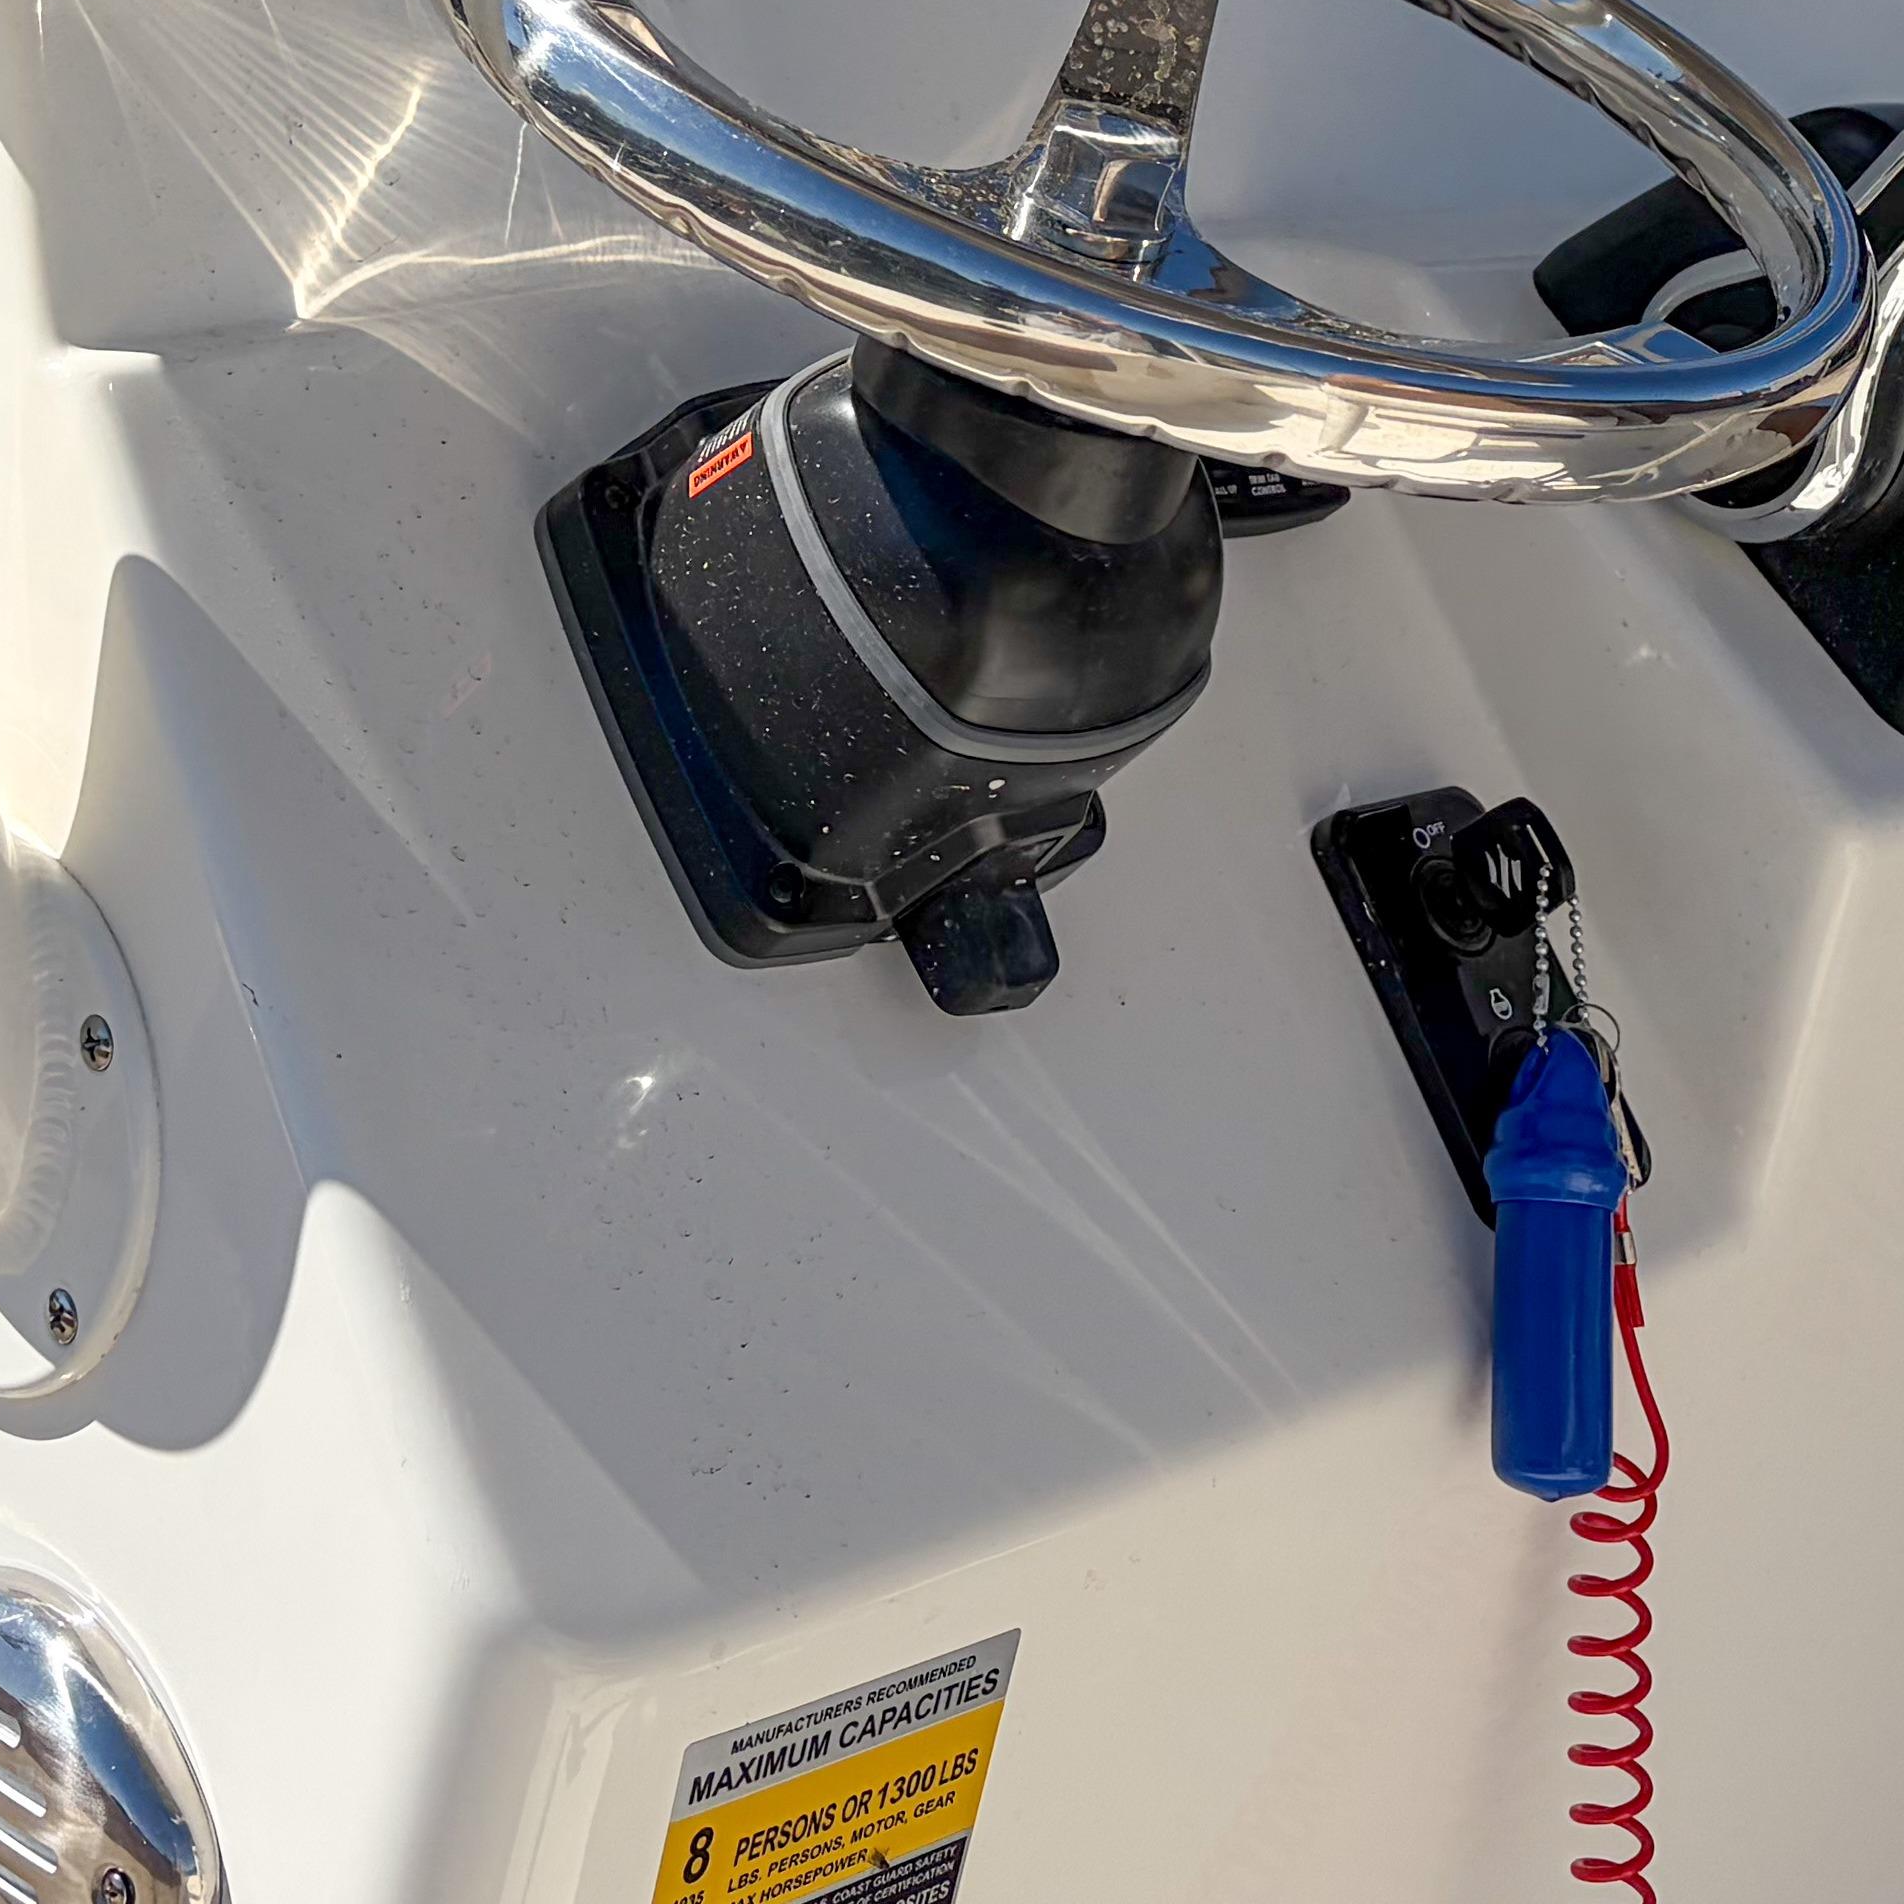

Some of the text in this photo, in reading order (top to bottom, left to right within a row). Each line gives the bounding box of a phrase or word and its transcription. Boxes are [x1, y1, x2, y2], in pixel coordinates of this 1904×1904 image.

[1426, 821, 1446, 836] OFF
[688, 1667, 1000, 1805] MAXIMUM CAPACITIES
[730, 1654, 977, 1755] MANUFACTURERS RECOMMENDED
[683, 1747, 979, 1885] 8 PERSONS OR 1300 LBS
[727, 1867, 762, 1894] LBS.
[768, 1836, 845, 1883] PERSONS,
[850, 1809, 908, 1853] MOTOR,
[913, 1790, 955, 1820] GEAR
[759, 1848, 868, 1903] HORSEPOWER
[832, 1879, 870, 1904] COAST
[872, 1863, 914, 1888] GUARD
[914, 1845, 958, 1871] SAFETY
[873, 1860, 956, 1904] CERTIFICATION
